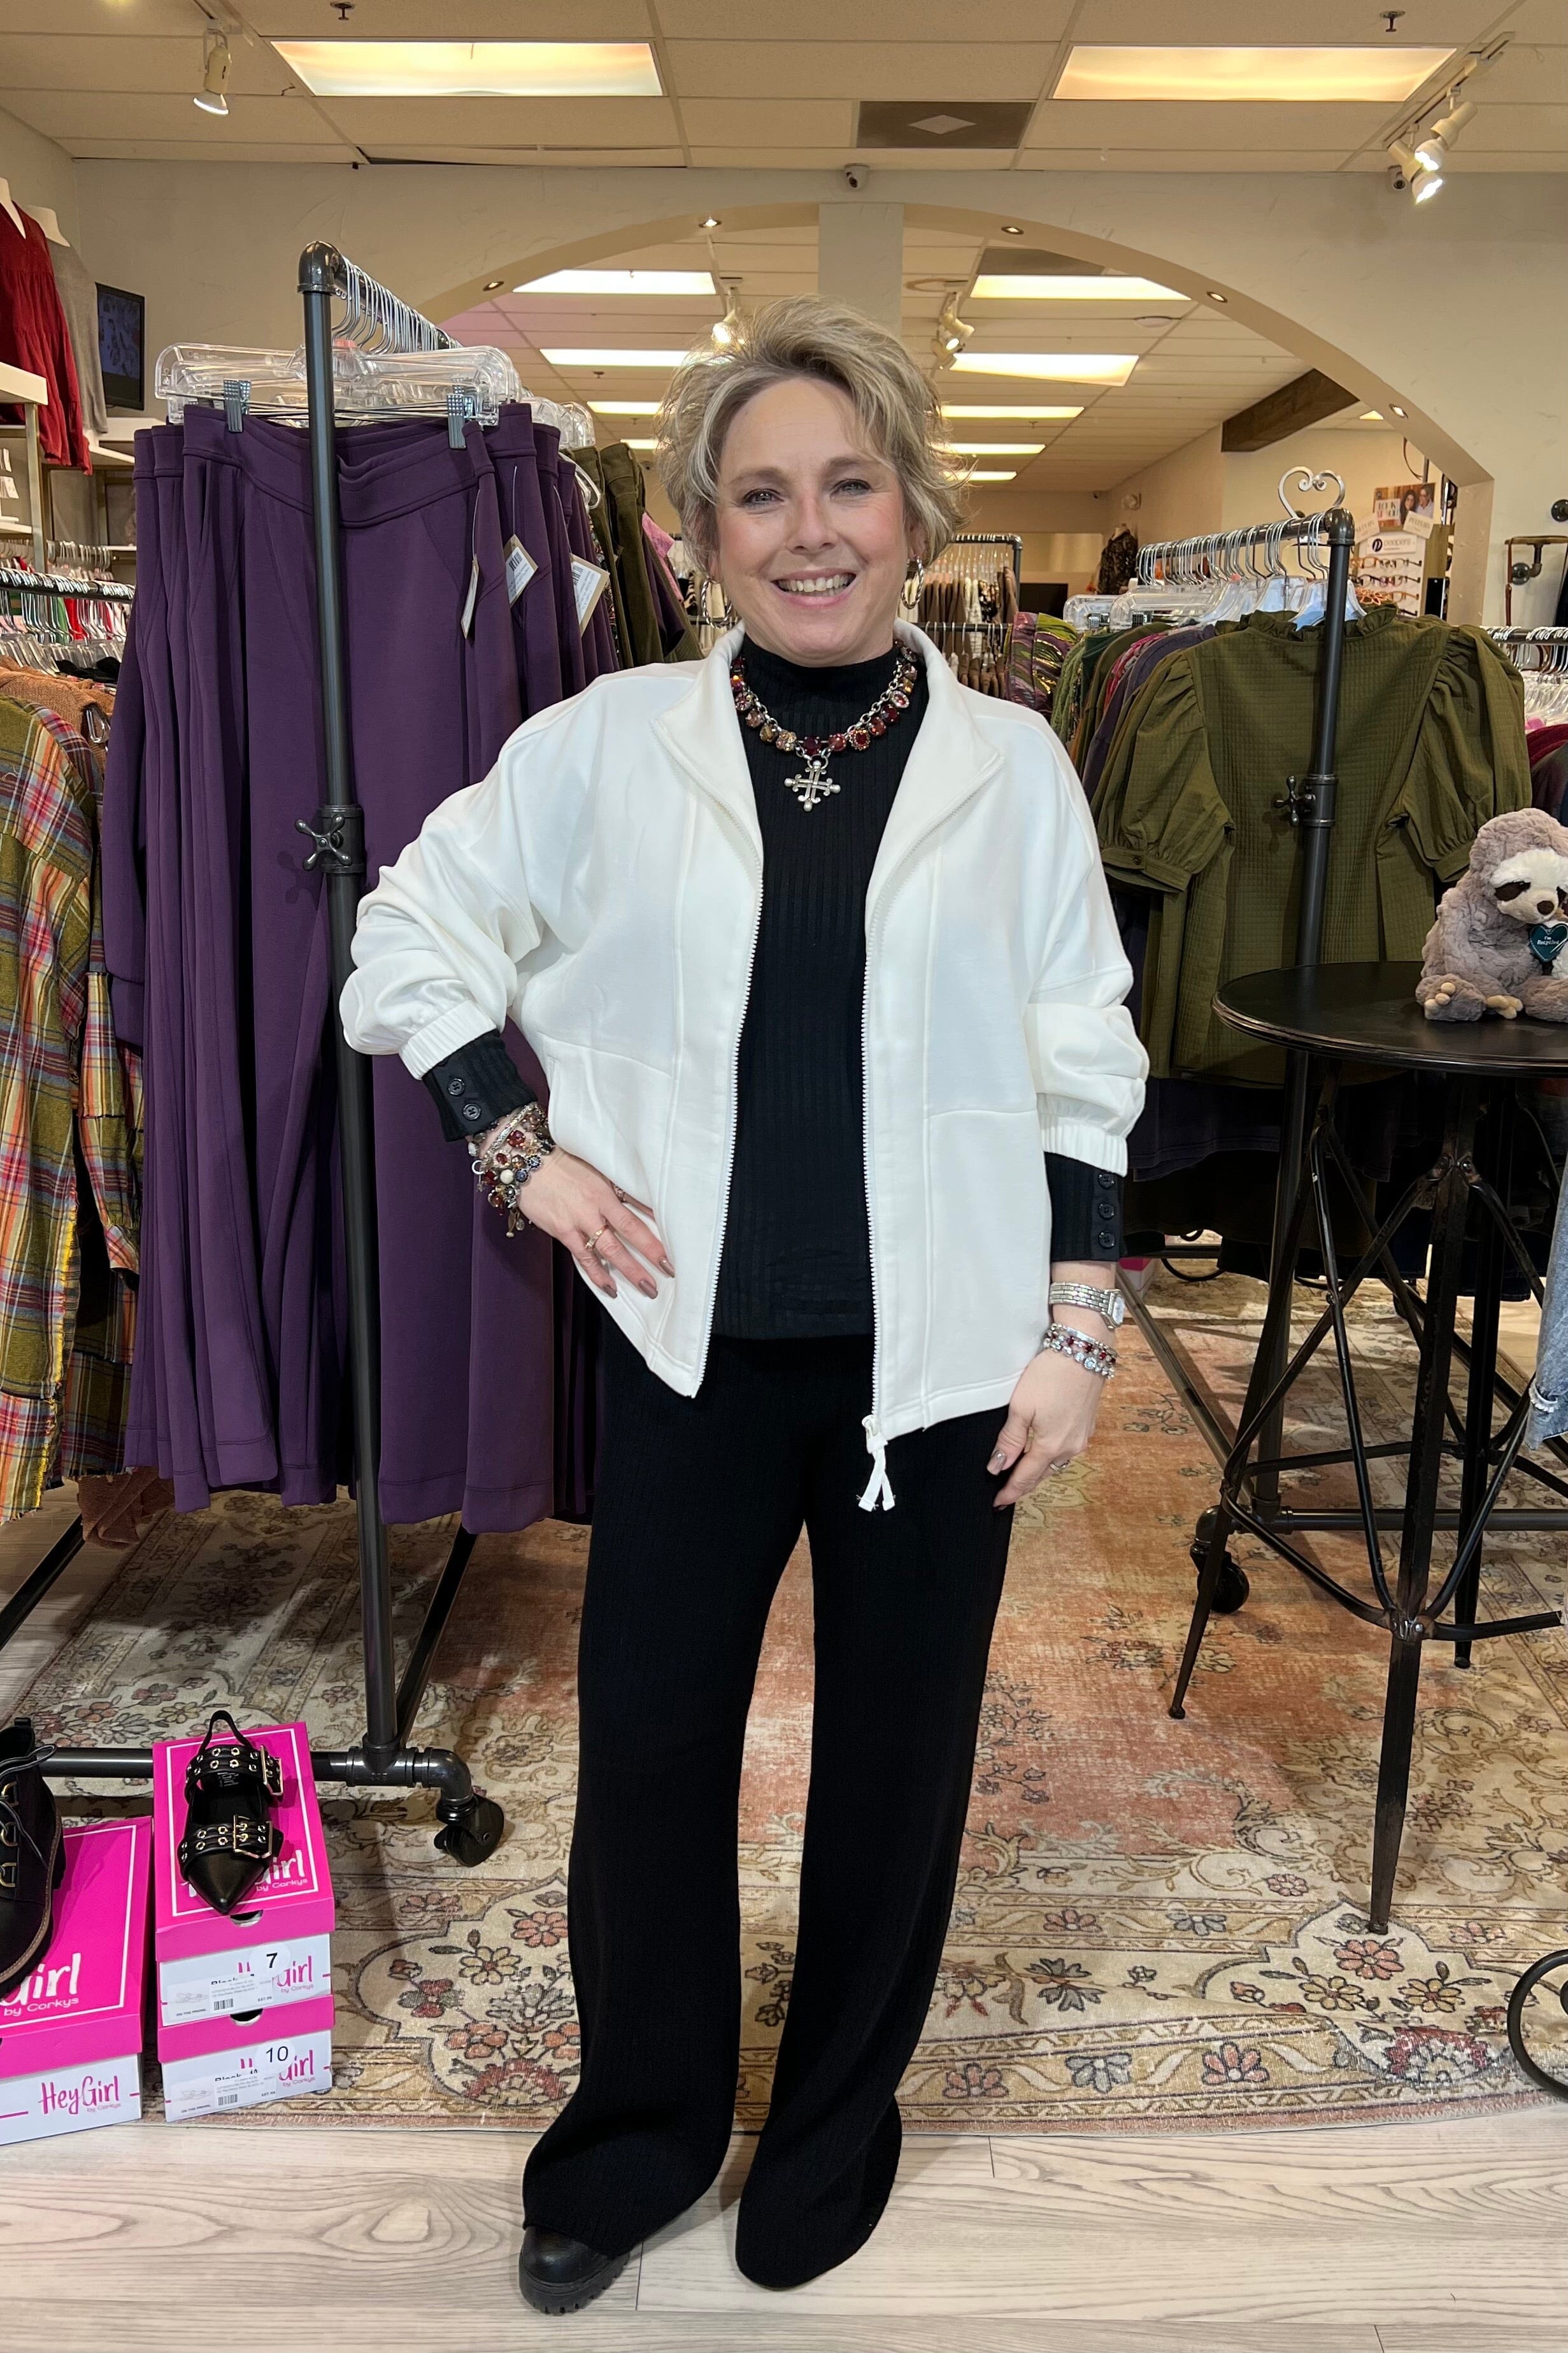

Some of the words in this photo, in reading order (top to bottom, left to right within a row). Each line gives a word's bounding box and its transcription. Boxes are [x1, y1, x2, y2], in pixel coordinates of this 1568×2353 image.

[272, 1878, 308, 1889] Corkys
[266, 1952, 278, 1968] 7
[3, 2007, 22, 2017] by
[27, 1998, 79, 2012] Corkys
[266, 2046, 289, 2063] 10
[292, 2077, 316, 2085] Corkys
[38, 2075, 120, 2115] HeyGirl
